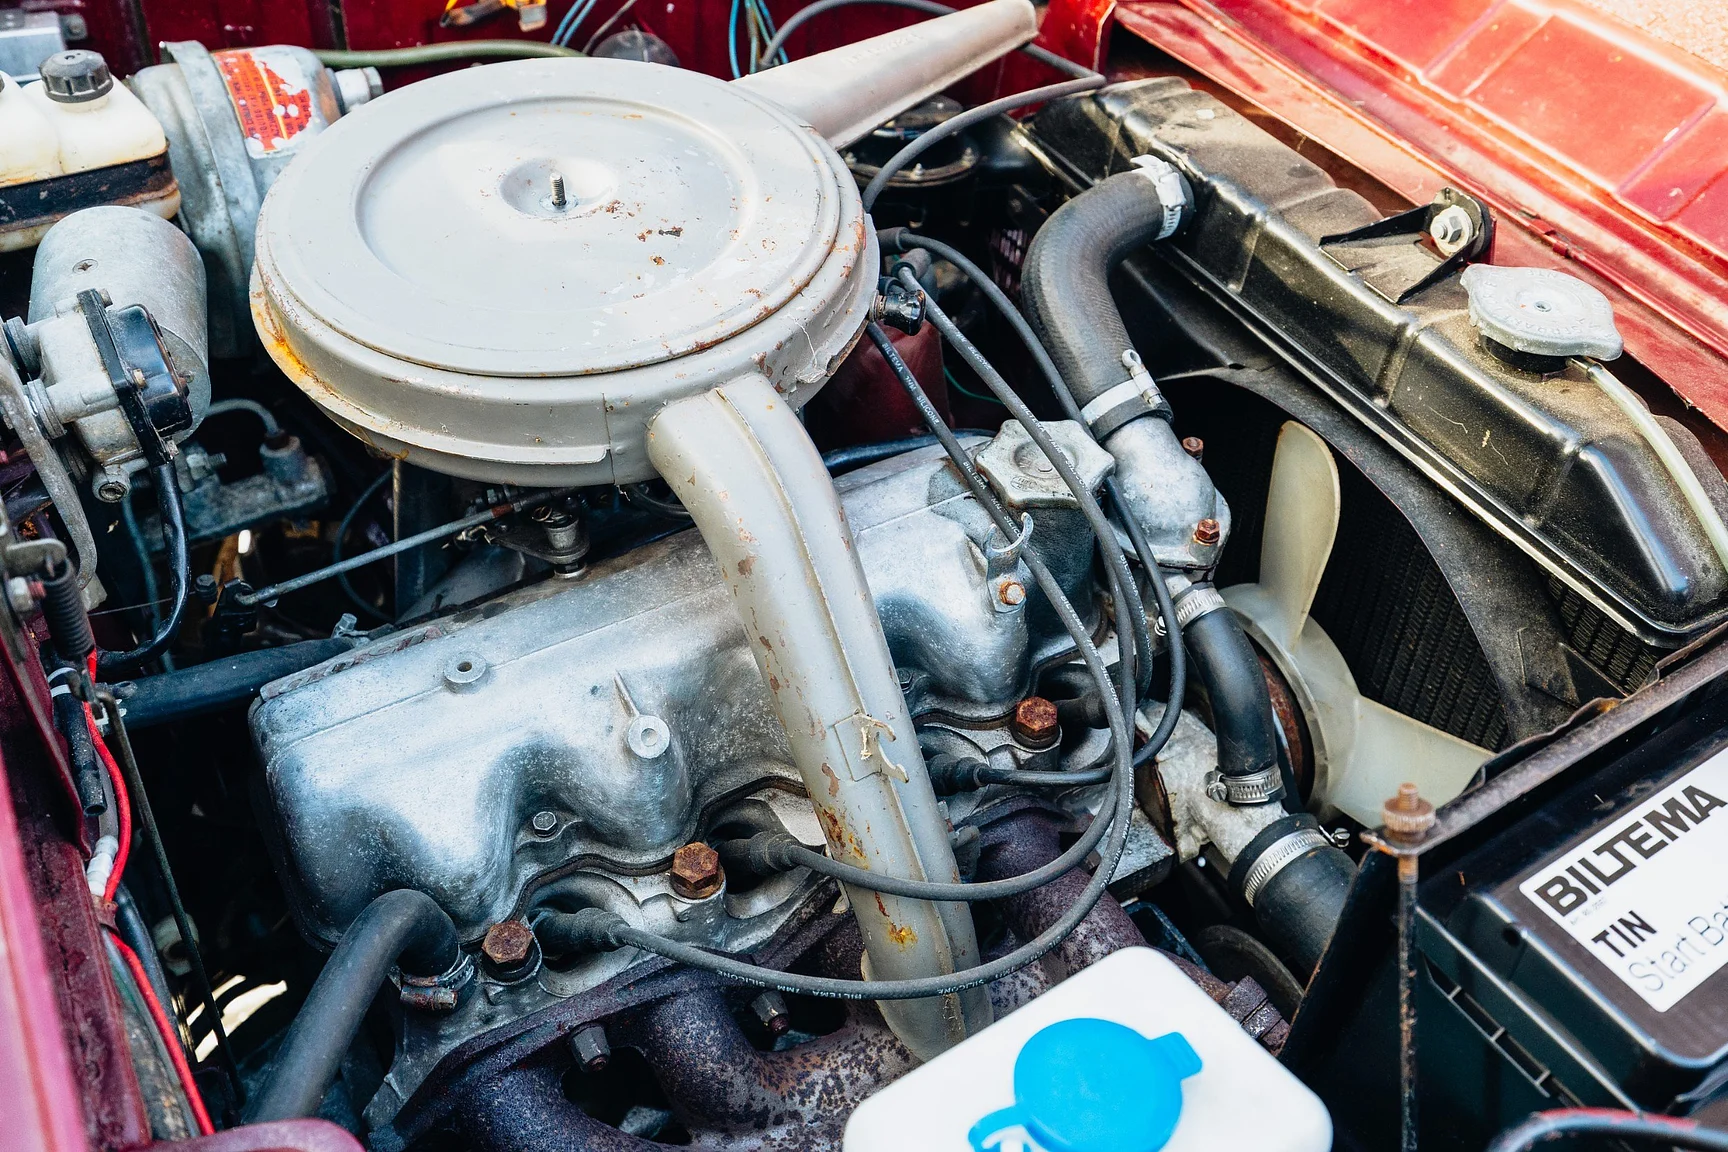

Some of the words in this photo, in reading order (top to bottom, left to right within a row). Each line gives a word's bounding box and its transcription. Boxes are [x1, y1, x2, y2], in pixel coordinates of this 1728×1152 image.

[881, 342, 904, 373] BILTEMA
[916, 394, 941, 425] SILICONE
[962, 461, 988, 490] BILTEMA
[1060, 595, 1085, 632] BILTEMA
[1100, 664, 1120, 707] SILICONE
[1534, 784, 1728, 918] BILTEMA
[1591, 910, 1658, 959] TIN
[1628, 933, 1706, 992] Start
[715, 969, 766, 988] SILICONE
